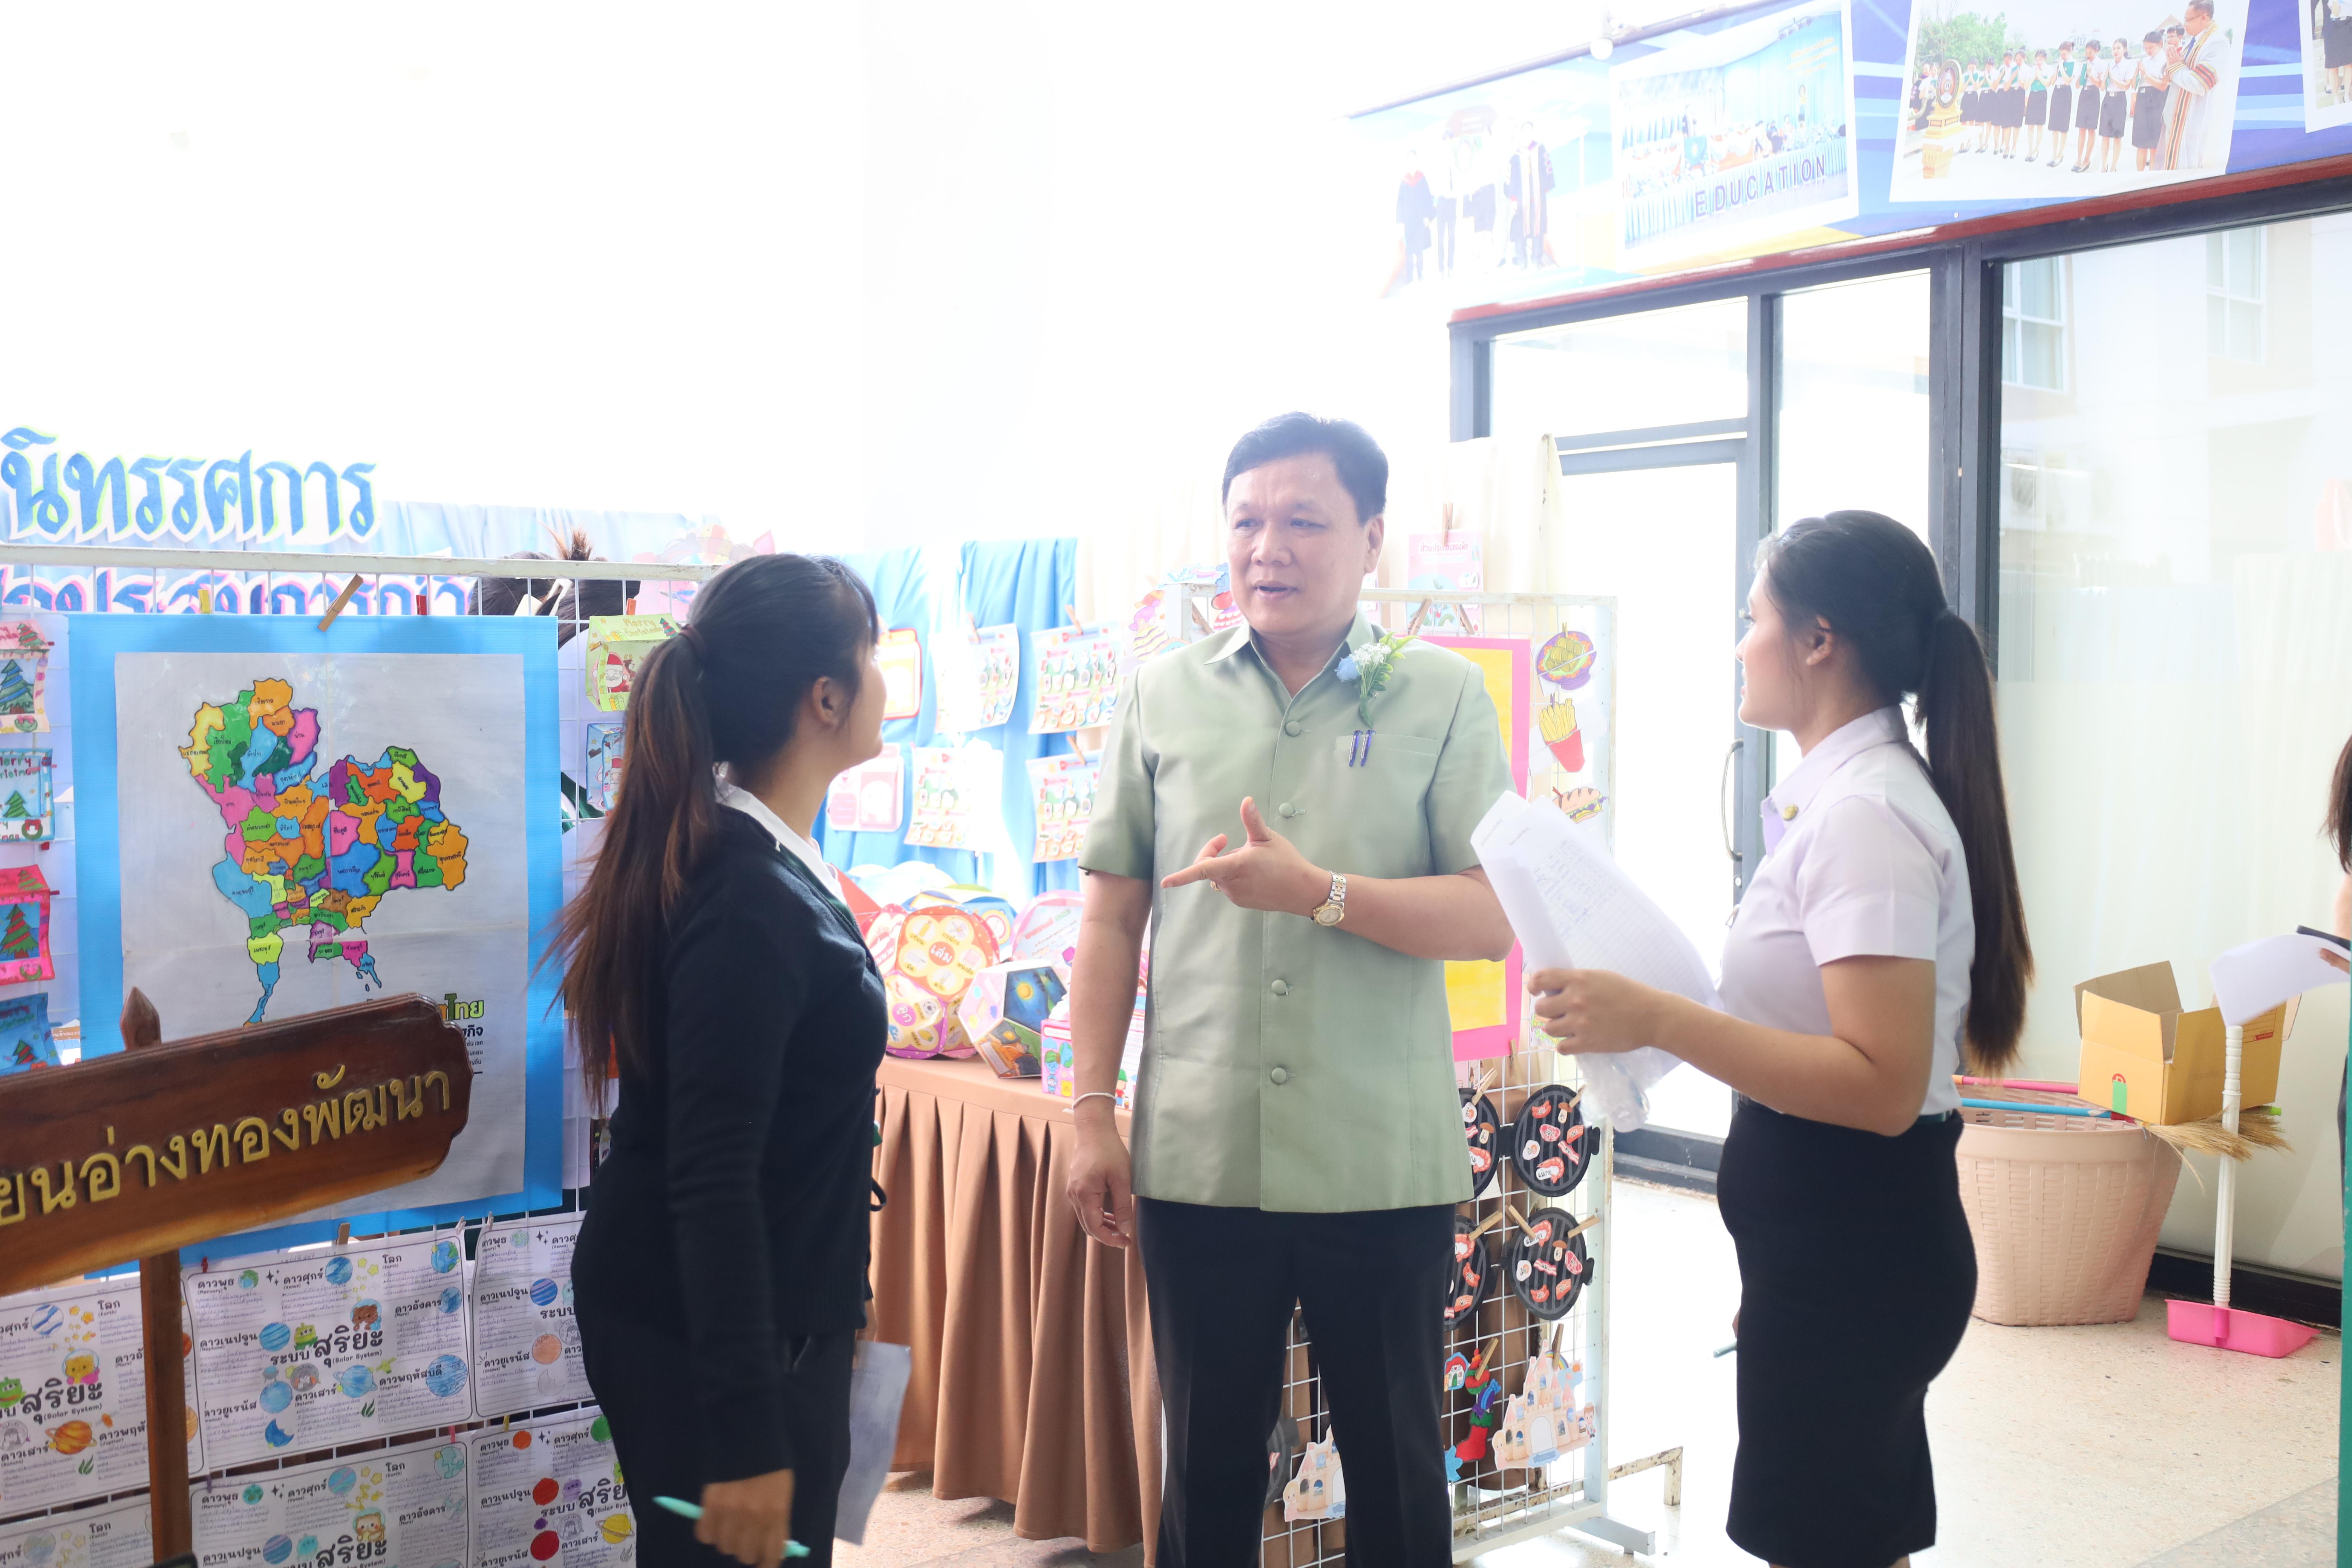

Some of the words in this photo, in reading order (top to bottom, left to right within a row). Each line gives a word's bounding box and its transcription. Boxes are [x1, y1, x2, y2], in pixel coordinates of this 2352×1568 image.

[1695, 154, 1827, 218] EDUCATION
[0, 427, 377, 537] นิทรรศการ
[623, 618, 656, 627] Merry
[930, 945, 953, 963] เล่ม
[897, 1006, 912, 1023] ลูก
[482, 1236, 507, 1248] ดาวพุธ
[382, 1254, 402, 1264] โลก
[284, 1267, 323, 1285] ดาวศุกร์
[198, 1278, 234, 1291] ดาวพุธ
[480, 1287, 528, 1301] ดาวเนปจูน
[97, 1300, 120, 1310] โลก
[395, 1299, 443, 1313] ดาวอังคาร
[200, 1332, 258, 1348] ดาวเนปจูน
[312, 1324, 383, 1368] สุริยะ
[270, 1350, 310, 1366] ระบบ
[484, 1351, 530, 1368] ดาวยูเรนัส
[380, 1364, 442, 1386] ดาวพฤหัสบดี
[295, 1383, 337, 1401] ดาวเสาร์
[20, 1377, 103, 1425] สุริยะ
[554, 1427, 590, 1444] ดาวศุกร์
[1, 1441, 49, 1462] ดาวเสาร์
[480, 1438, 509, 1452] ดาวพุธ
[386, 1462, 405, 1472] โลก
[288, 1478, 327, 1496] ดาวศุกร์
[202, 1493, 239, 1505] ดาวพุธ
[481, 1489, 531, 1506] ดาวเนปจูน
[399, 1505, 446, 1521] ดาวอังคาร
[541, 1502, 575, 1517] ระบบ
[89, 1522, 111, 1533] โลก
[562, 1531, 599, 1549] ดาวเสาร์
[204, 1547, 261, 1563] ดาวเนปจูน
